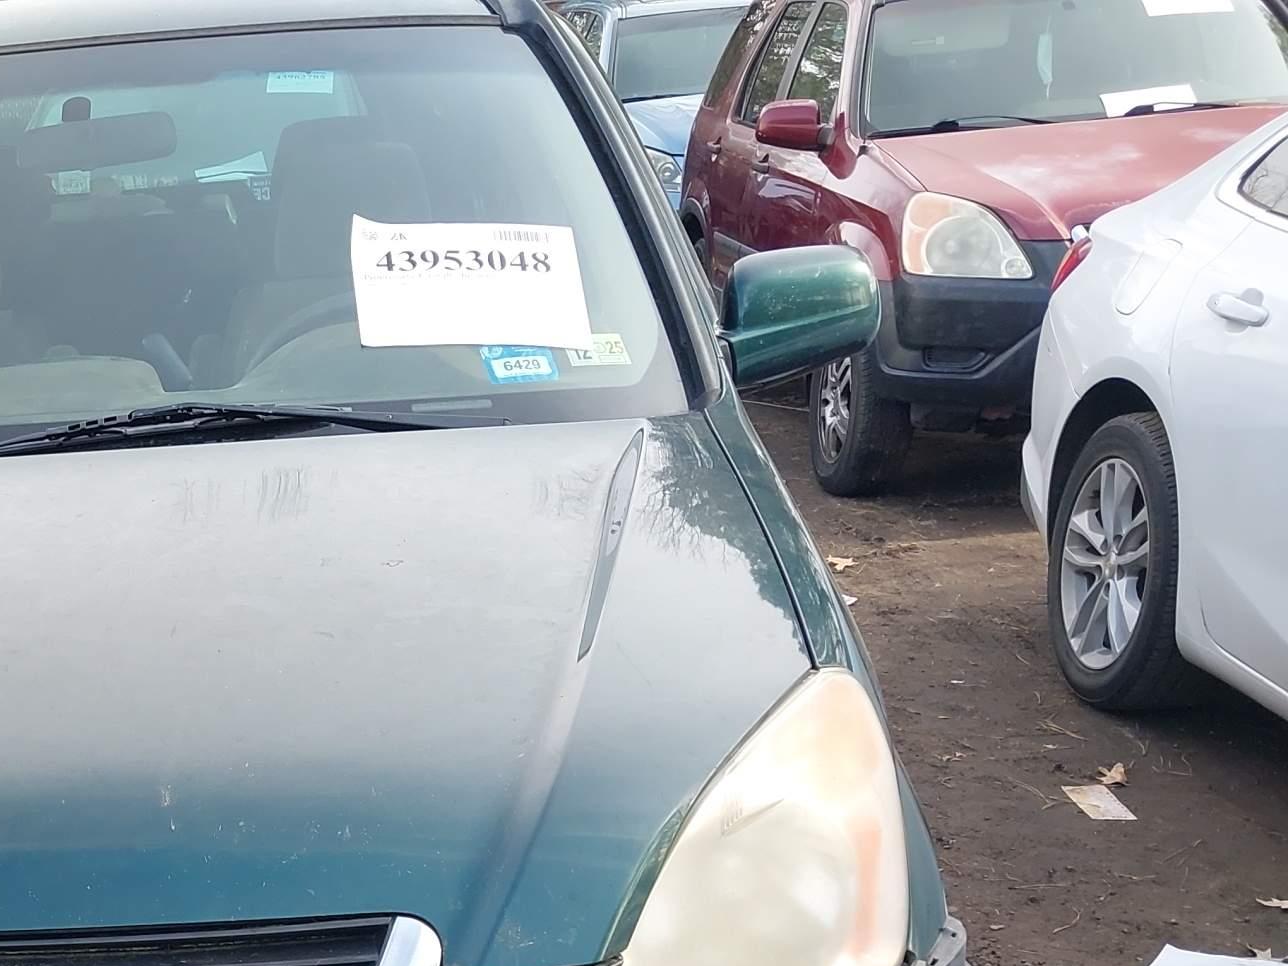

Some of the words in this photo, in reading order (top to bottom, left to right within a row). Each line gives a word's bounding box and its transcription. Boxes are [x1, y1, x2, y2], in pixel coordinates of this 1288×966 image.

[376, 249, 552, 273] 43953048
[606, 340, 624, 354] 25
[503, 358, 542, 372] 6429
